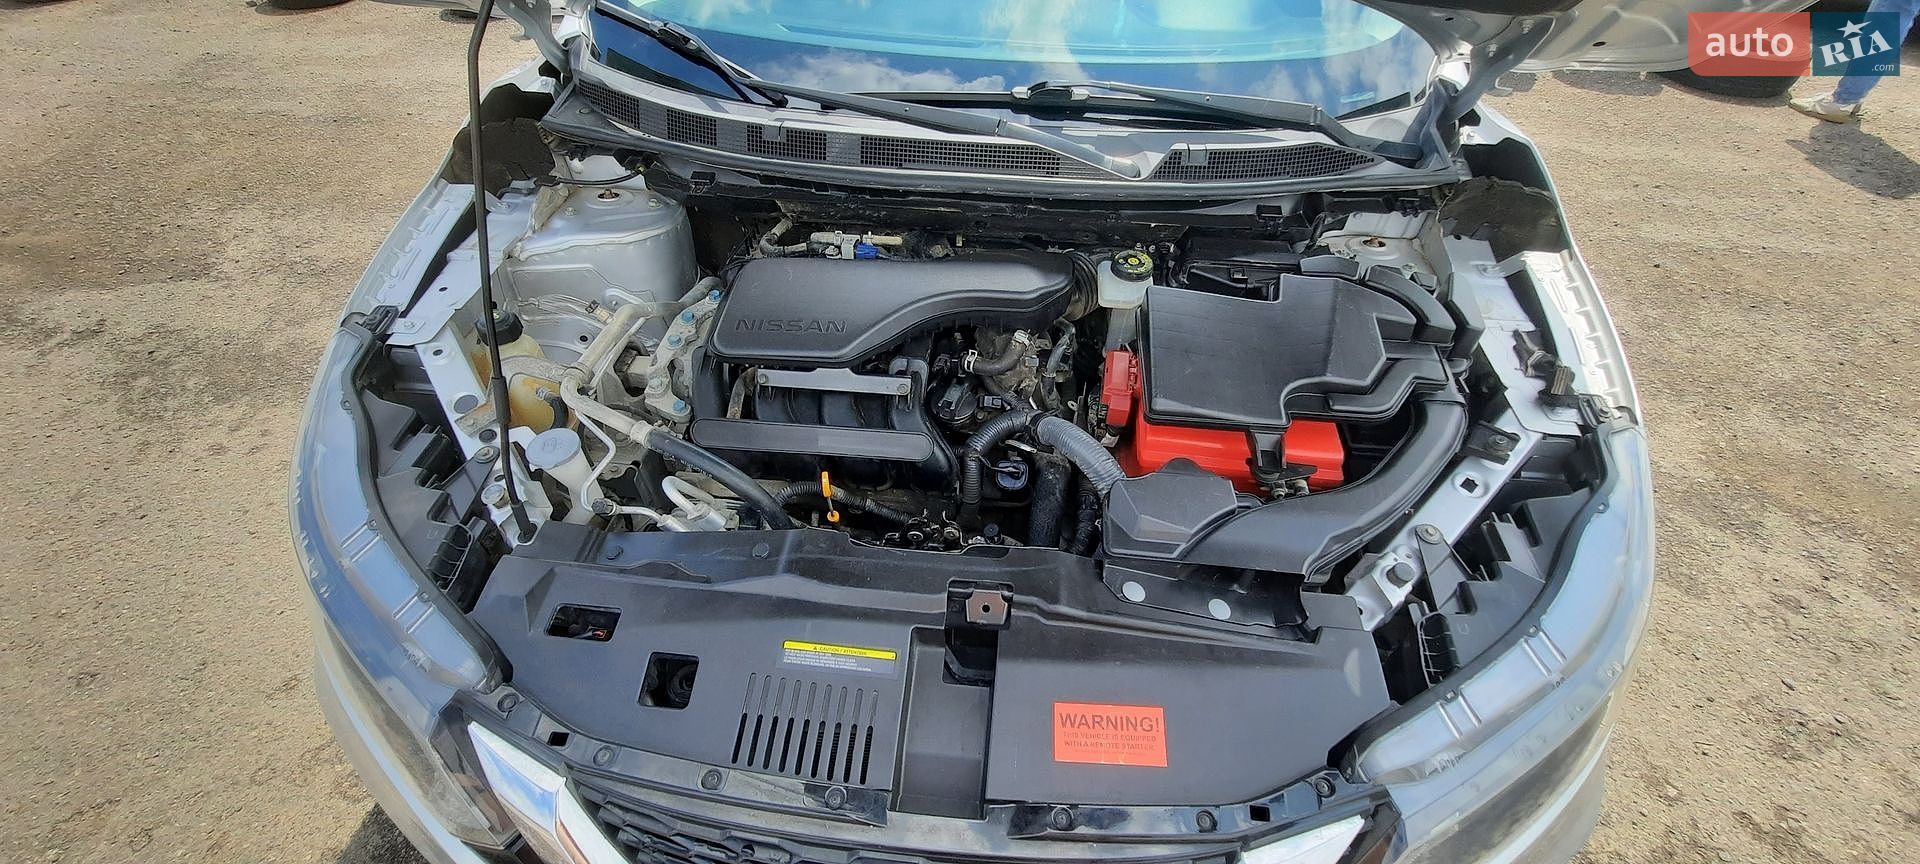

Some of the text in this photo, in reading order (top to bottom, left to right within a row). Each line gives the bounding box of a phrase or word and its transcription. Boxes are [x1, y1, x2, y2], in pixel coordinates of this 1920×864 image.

[735, 319, 848, 333] NISSAN
[1059, 713, 1160, 733] WARNING!
[1080, 732, 1112, 740] VEHICLE
[1120, 734, 1157, 742] EQUIPPED
[1089, 741, 1120, 749] REMOTE
